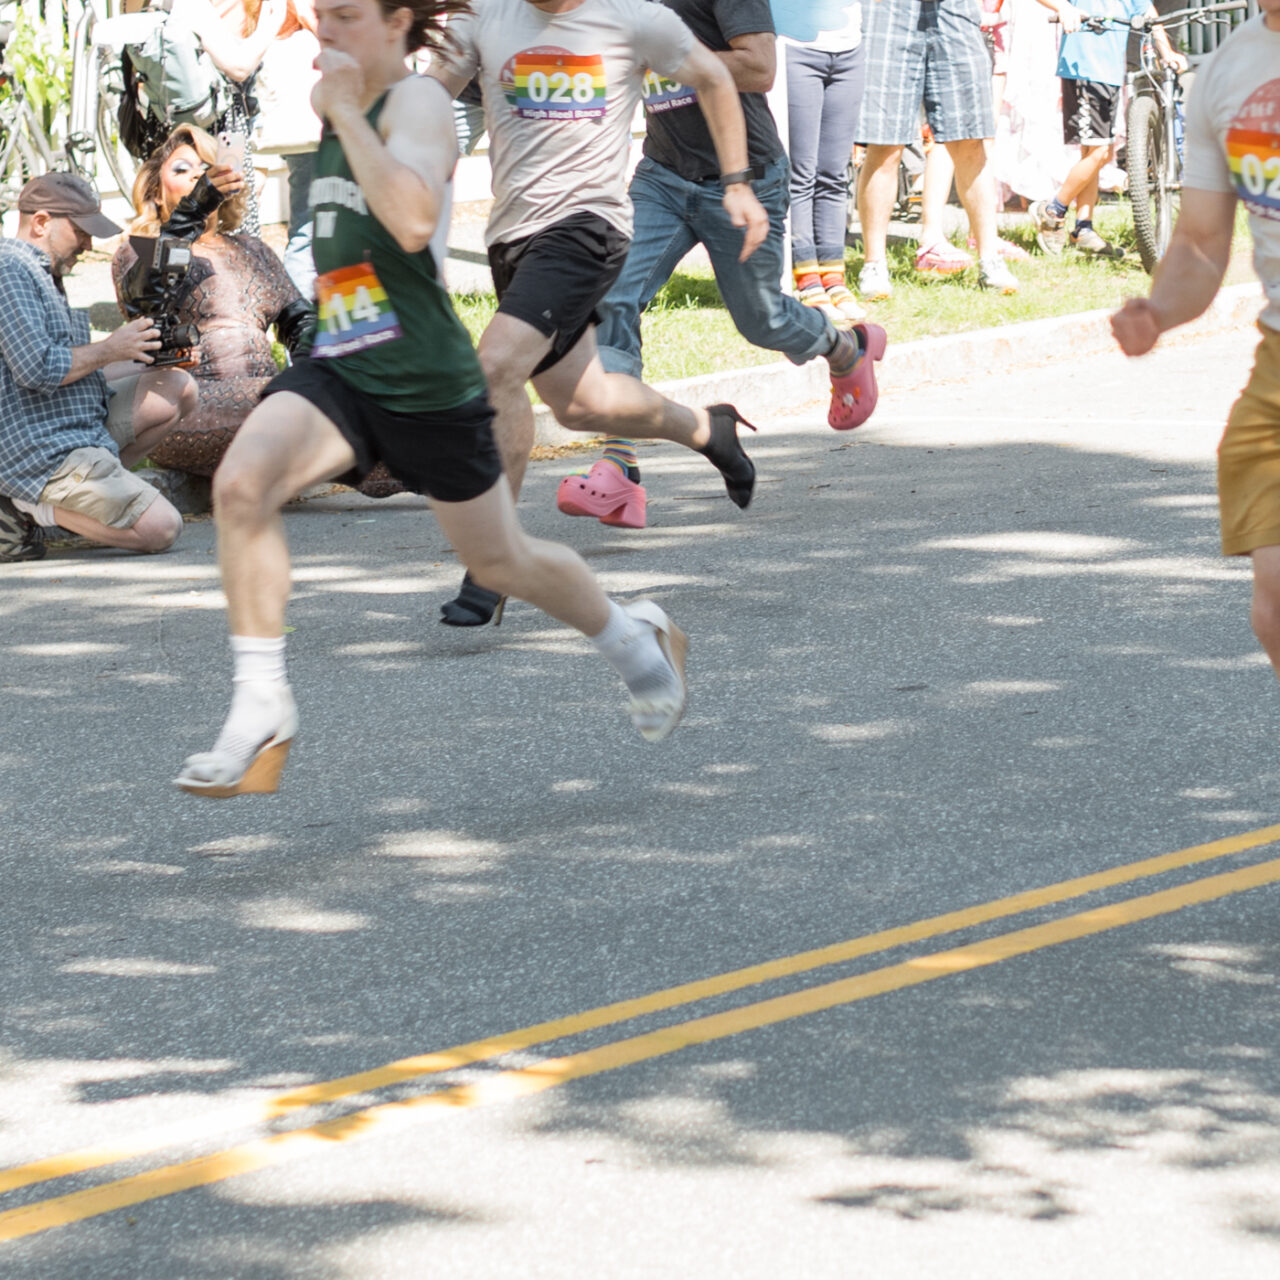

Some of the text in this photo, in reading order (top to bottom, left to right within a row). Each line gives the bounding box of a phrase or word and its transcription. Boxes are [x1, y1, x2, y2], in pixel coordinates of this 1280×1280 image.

[527, 71, 596, 104] 028
[670, 96, 693, 108] Race
[522, 109, 603, 120] High Heel Race
